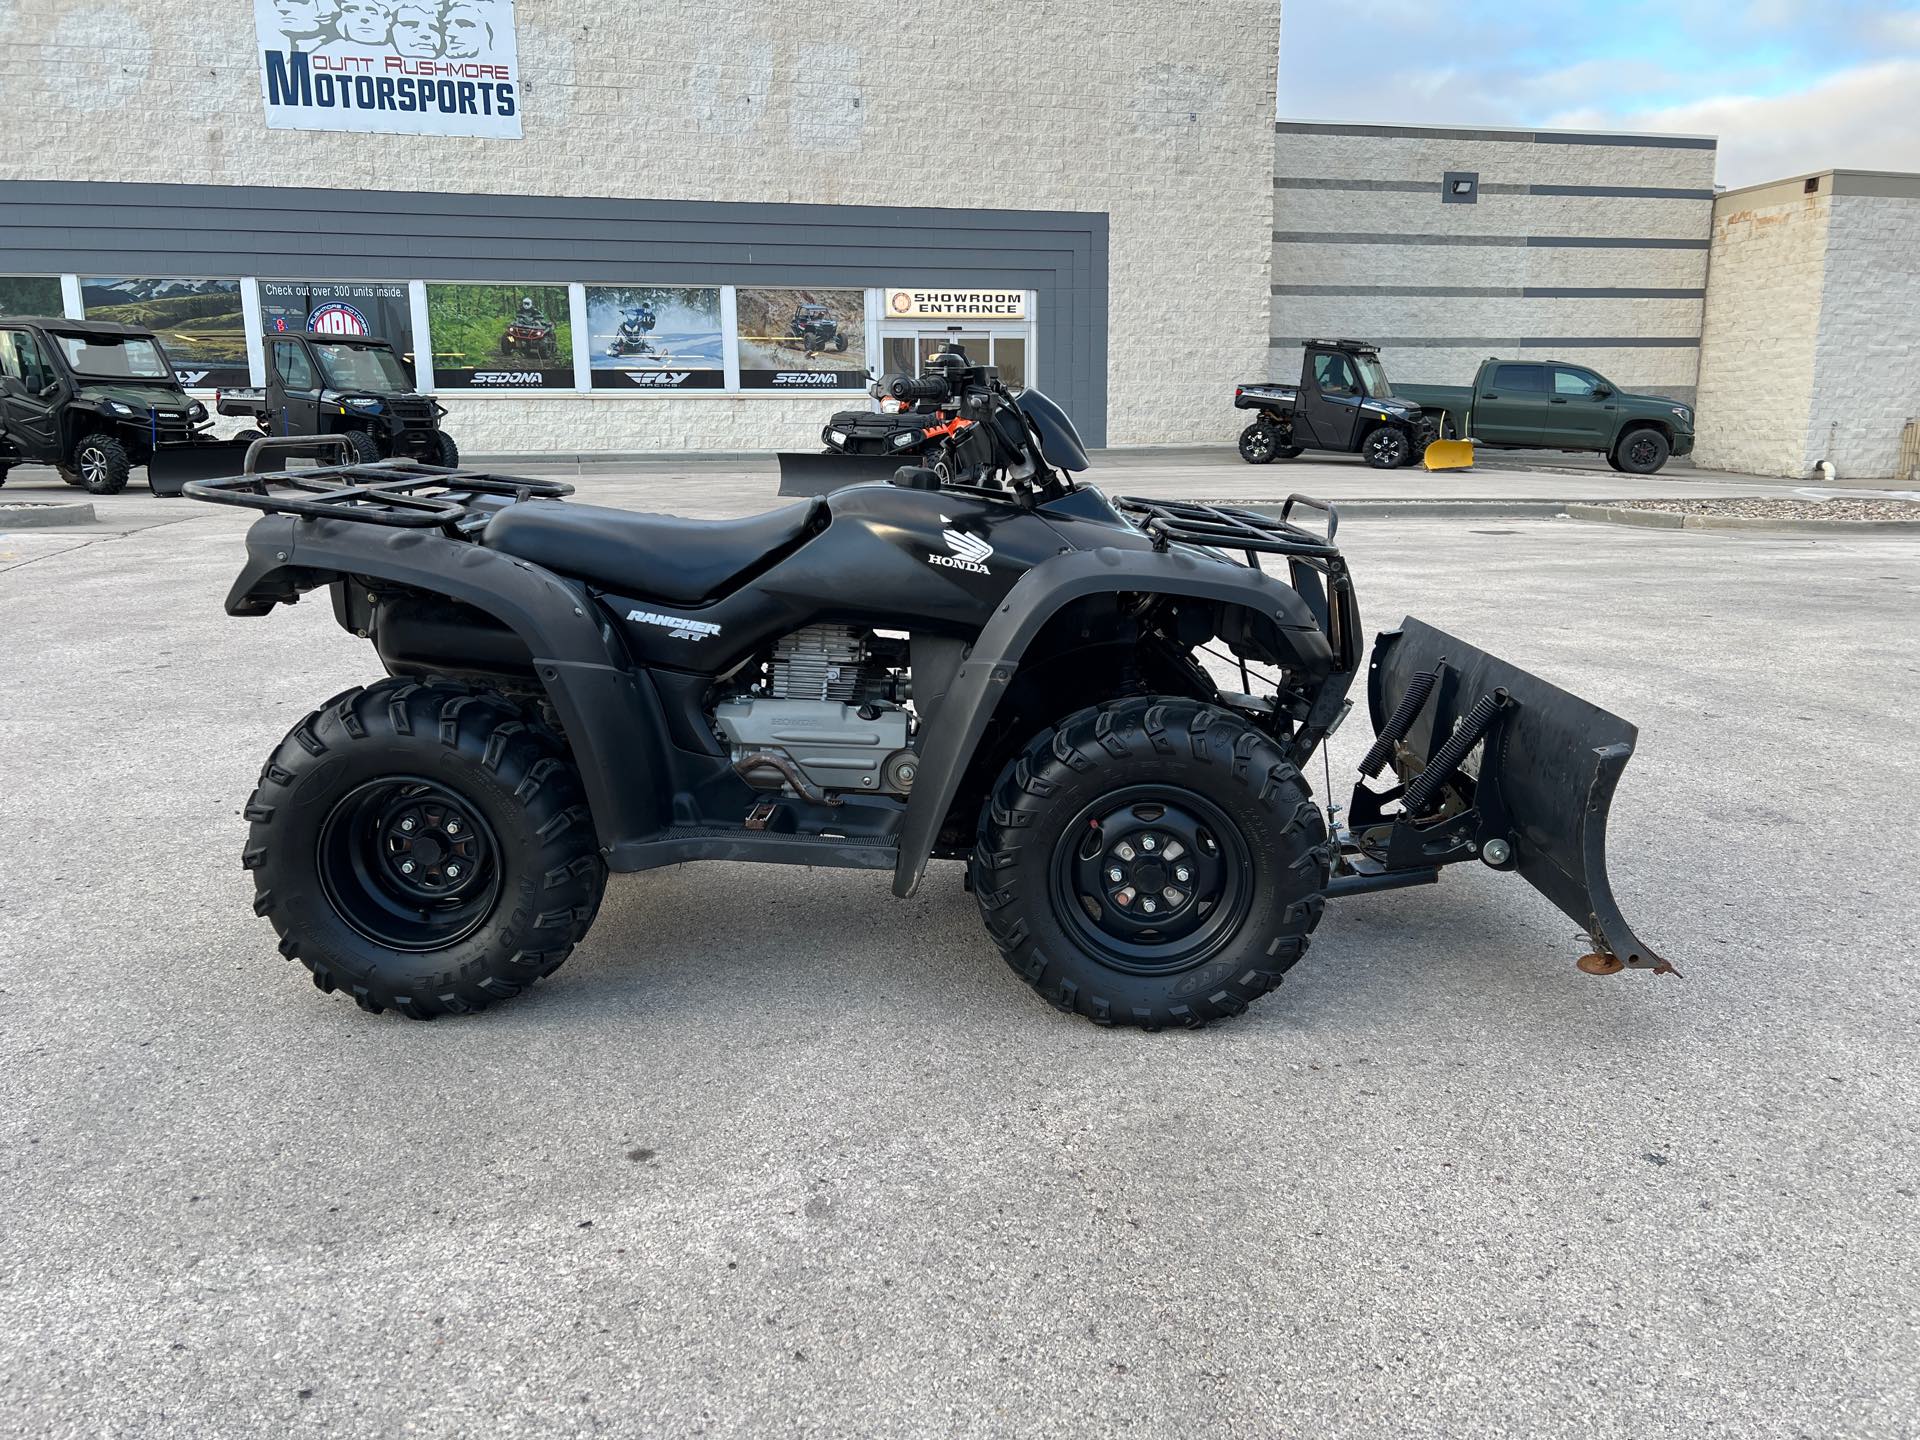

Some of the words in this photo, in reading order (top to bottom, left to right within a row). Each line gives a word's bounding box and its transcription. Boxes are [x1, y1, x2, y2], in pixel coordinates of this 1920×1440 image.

[384, 56, 509, 80] RUSHMORE
[265, 50, 515, 116] MOTORSPORTS
[265, 284, 293, 295] Check
[296, 285, 310, 296] out
[312, 287, 331, 297] over
[334, 286, 350, 297] 300
[353, 286, 374, 297] units
[376, 286, 404, 298] inside.
[914, 293, 1021, 303] SHOWROOM
[920, 304, 1017, 313] ENTRANCE
[174, 371, 210, 383] LY
[470, 372, 543, 384] SEDONA
[625, 372, 691, 384] FLY
[772, 372, 838, 384] SEDONA
[928, 554, 991, 576] HONDA
[626, 610, 722, 637] RANCHER
[668, 628, 709, 642] AT
